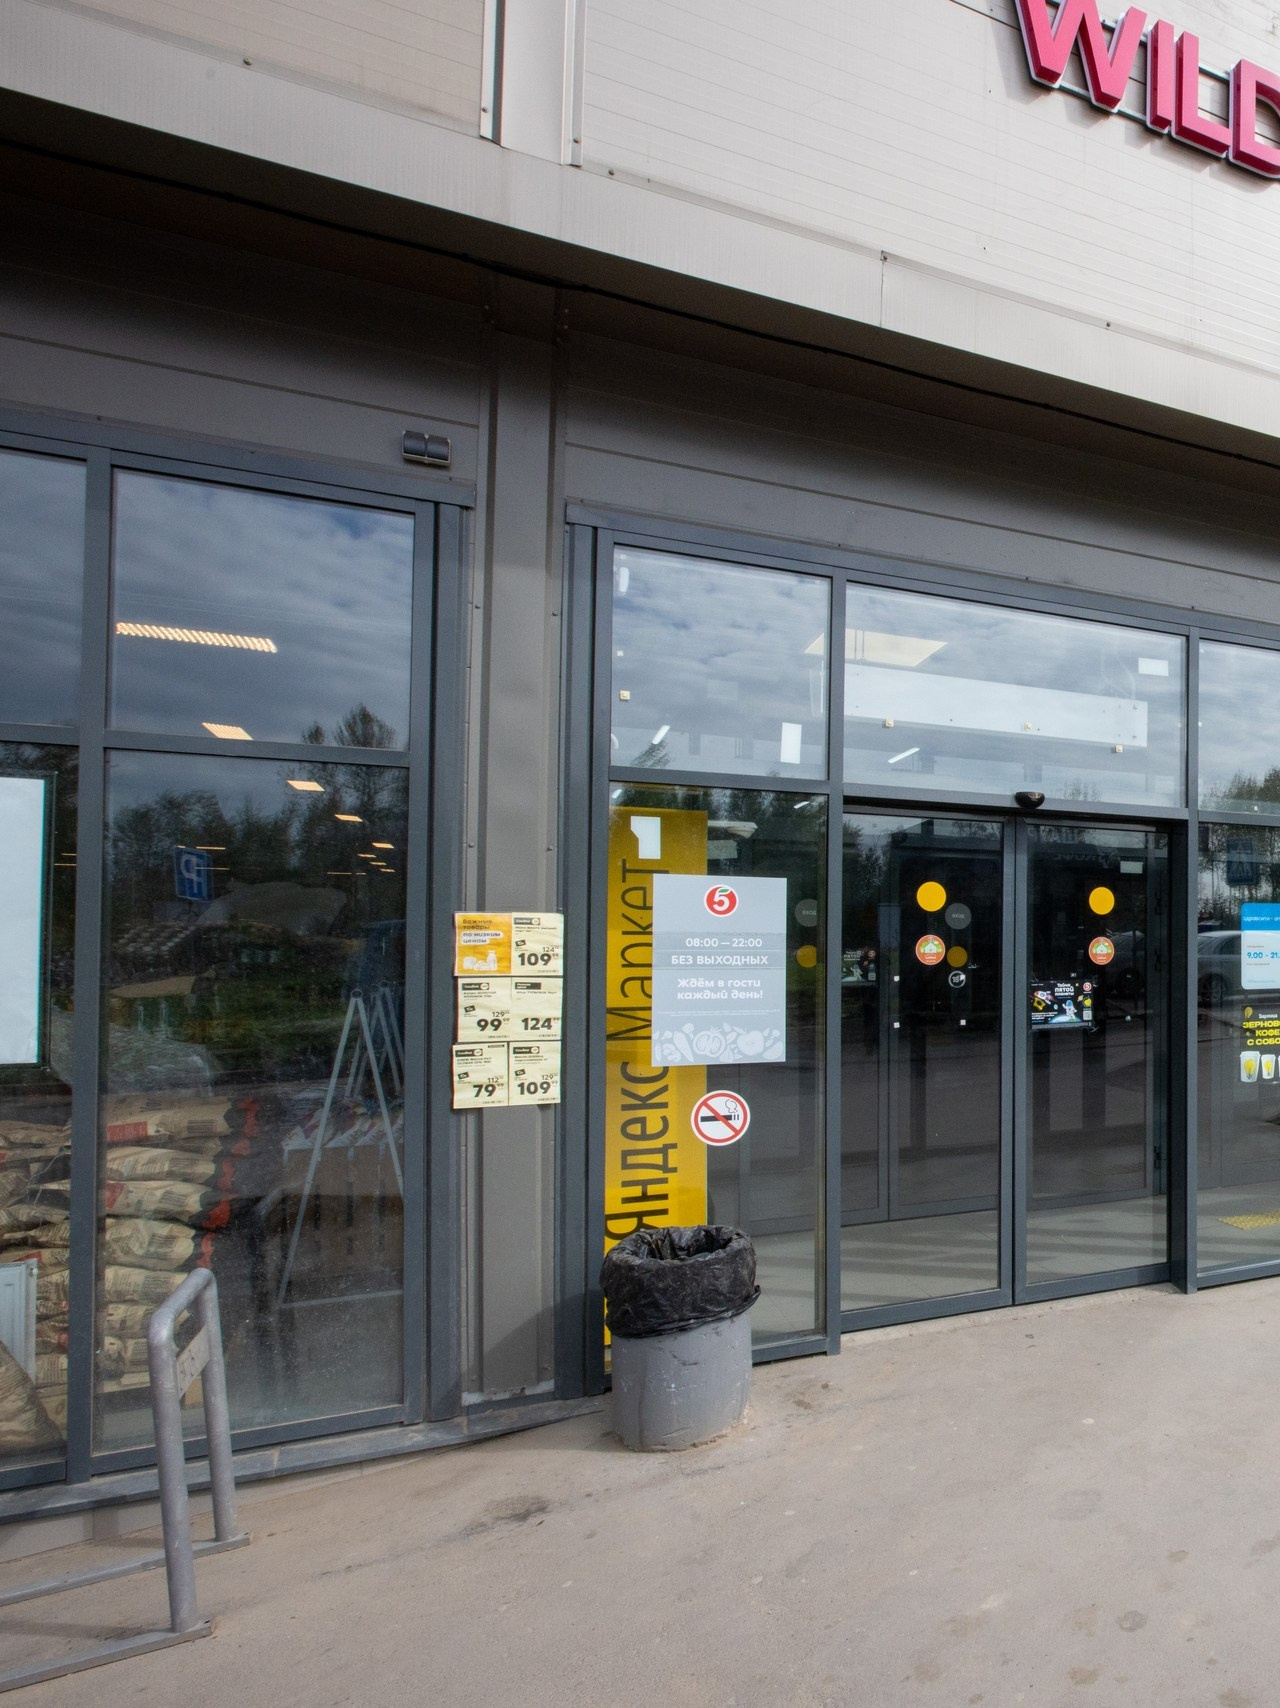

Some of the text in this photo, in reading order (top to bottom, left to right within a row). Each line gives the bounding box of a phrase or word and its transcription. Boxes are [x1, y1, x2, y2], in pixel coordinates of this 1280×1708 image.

[685, 937, 719, 948] 08:00
[732, 937, 763, 948] 22:00
[518, 952, 552, 966] 109
[671, 954, 769, 966] БЕЗ ВЫХОДНЫХ
[1246, 951, 1263, 959] 9.00
[677, 978, 761, 988] Ждём в гости
[676, 989, 764, 1000] каждый день!
[476, 1018, 502, 1032] 99
[521, 1017, 552, 1031] 124
[1255, 1028, 1280, 1037] КОФЕ
[1246, 1038, 1255, 1046] С
[472, 1083, 497, 1097] 79
[517, 1080, 551, 1095] 109
[605, 1061, 678, 1241] Яндекс
